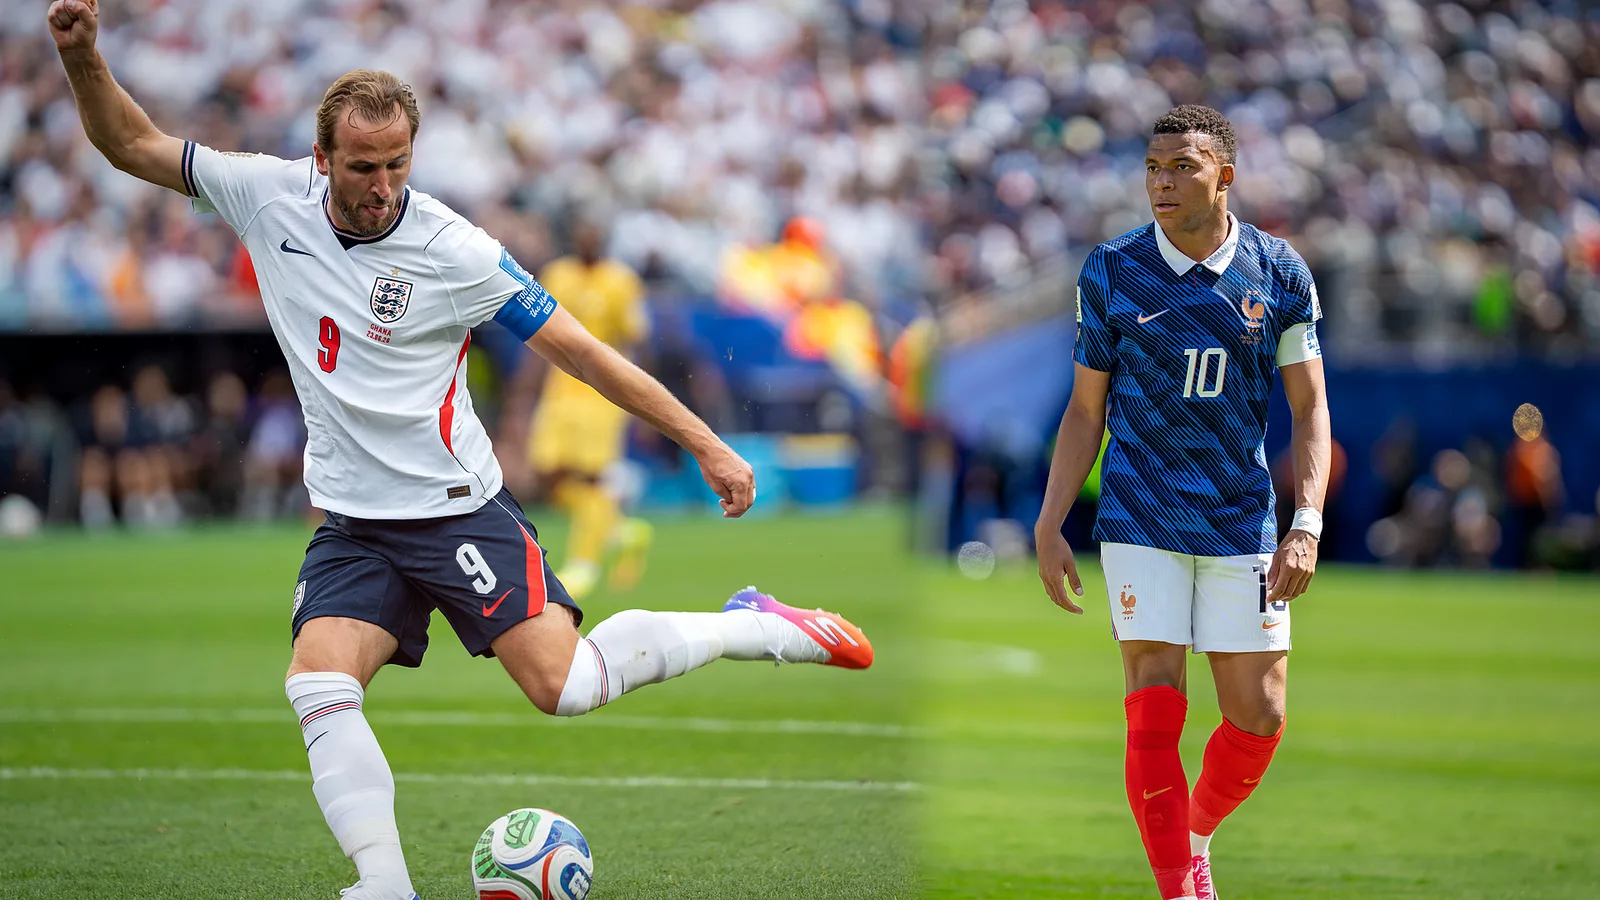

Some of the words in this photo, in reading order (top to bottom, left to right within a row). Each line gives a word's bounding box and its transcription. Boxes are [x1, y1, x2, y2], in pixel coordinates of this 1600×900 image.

[369, 323, 391, 337] GHANA
[528, 305, 542, 318] the
[317, 315, 341, 374] 9
[366, 330, 391, 344] 23.06.26
[1183, 347, 1228, 398] 10
[455, 542, 497, 595] 9
[1252, 565, 1287, 614] 1
